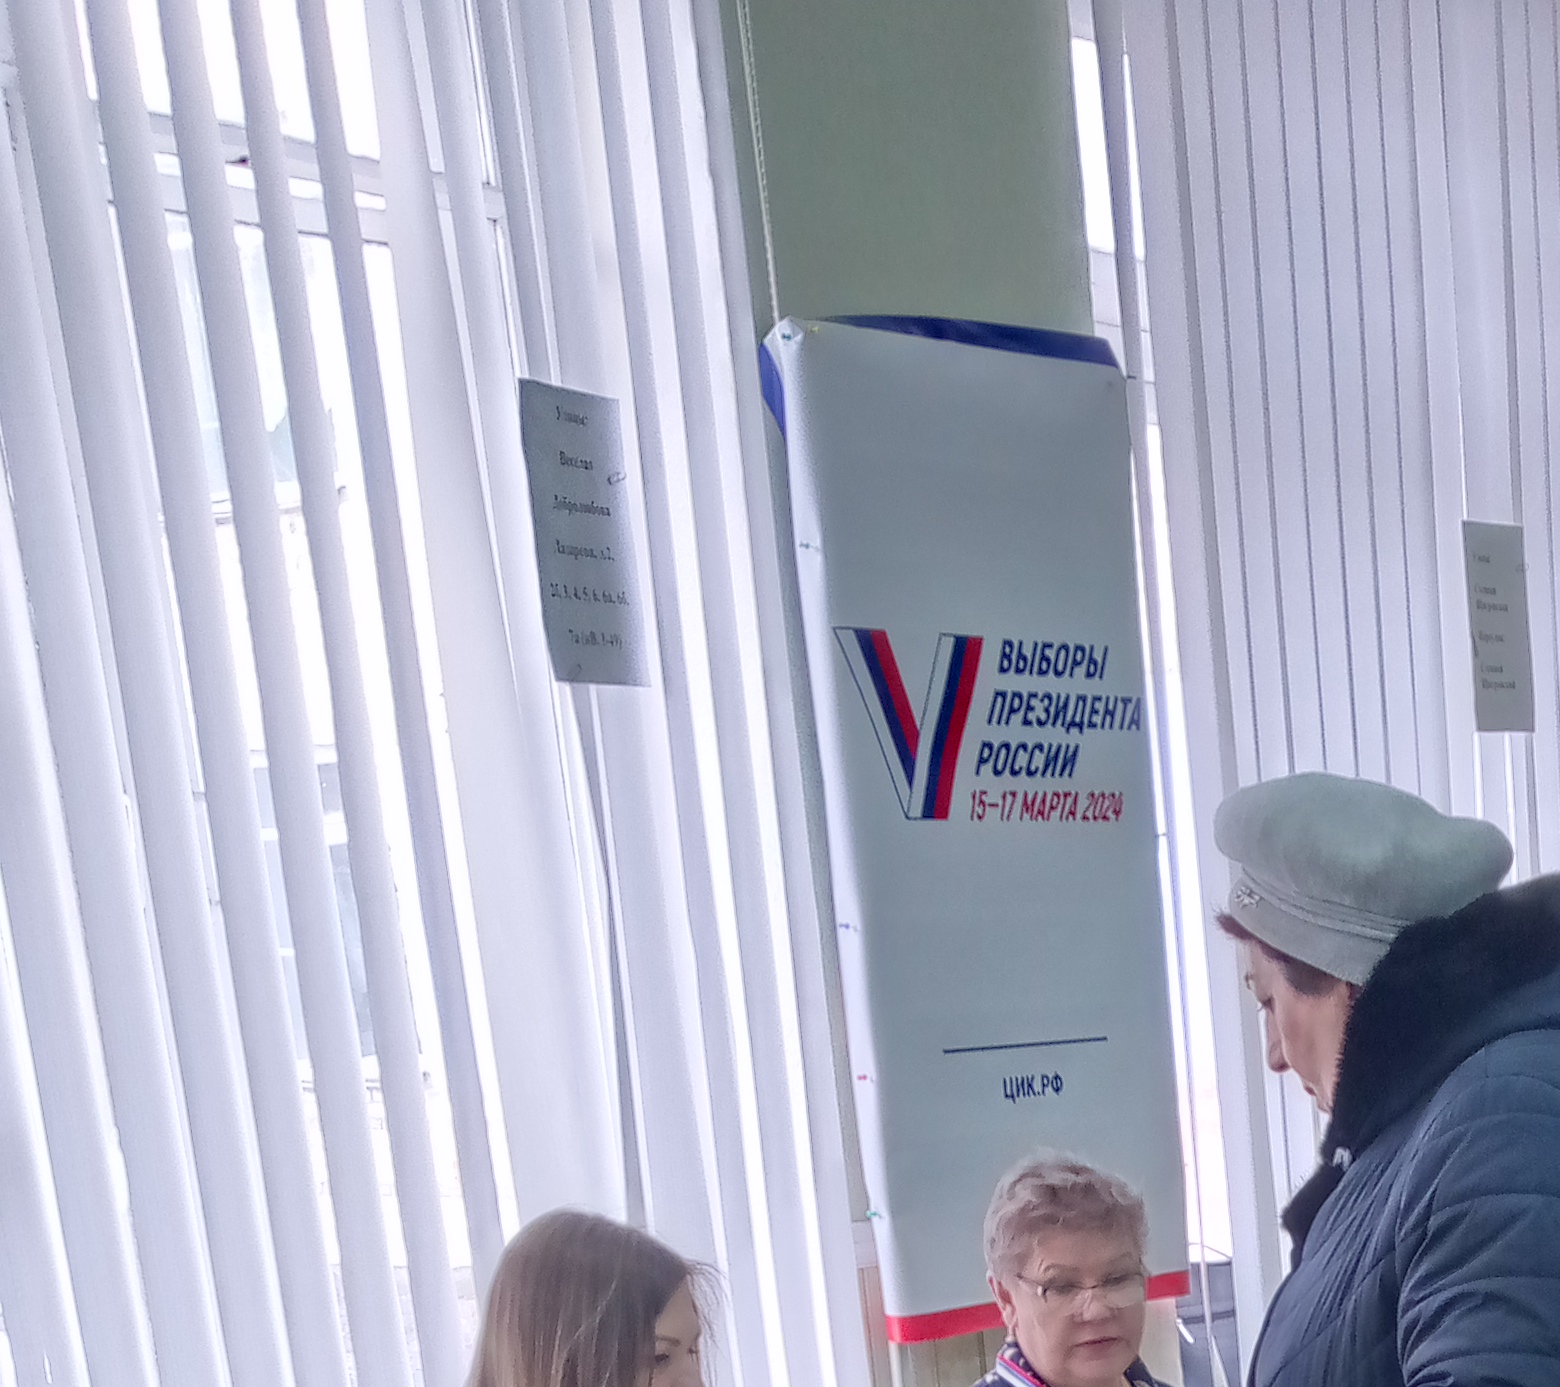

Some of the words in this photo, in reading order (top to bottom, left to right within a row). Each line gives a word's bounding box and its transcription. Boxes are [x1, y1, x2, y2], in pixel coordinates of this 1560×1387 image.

[998, 638, 1109, 680] ВЫБОРЫ
[986, 688, 1143, 735] ПРЕЗИДЕНТА
[975, 740, 1080, 779] РОССИИ
[1019, 791, 1079, 822] МАРТА
[1081, 792, 1123, 822] 2024
[1003, 1071, 1063, 1104] ЦИК.РФ
